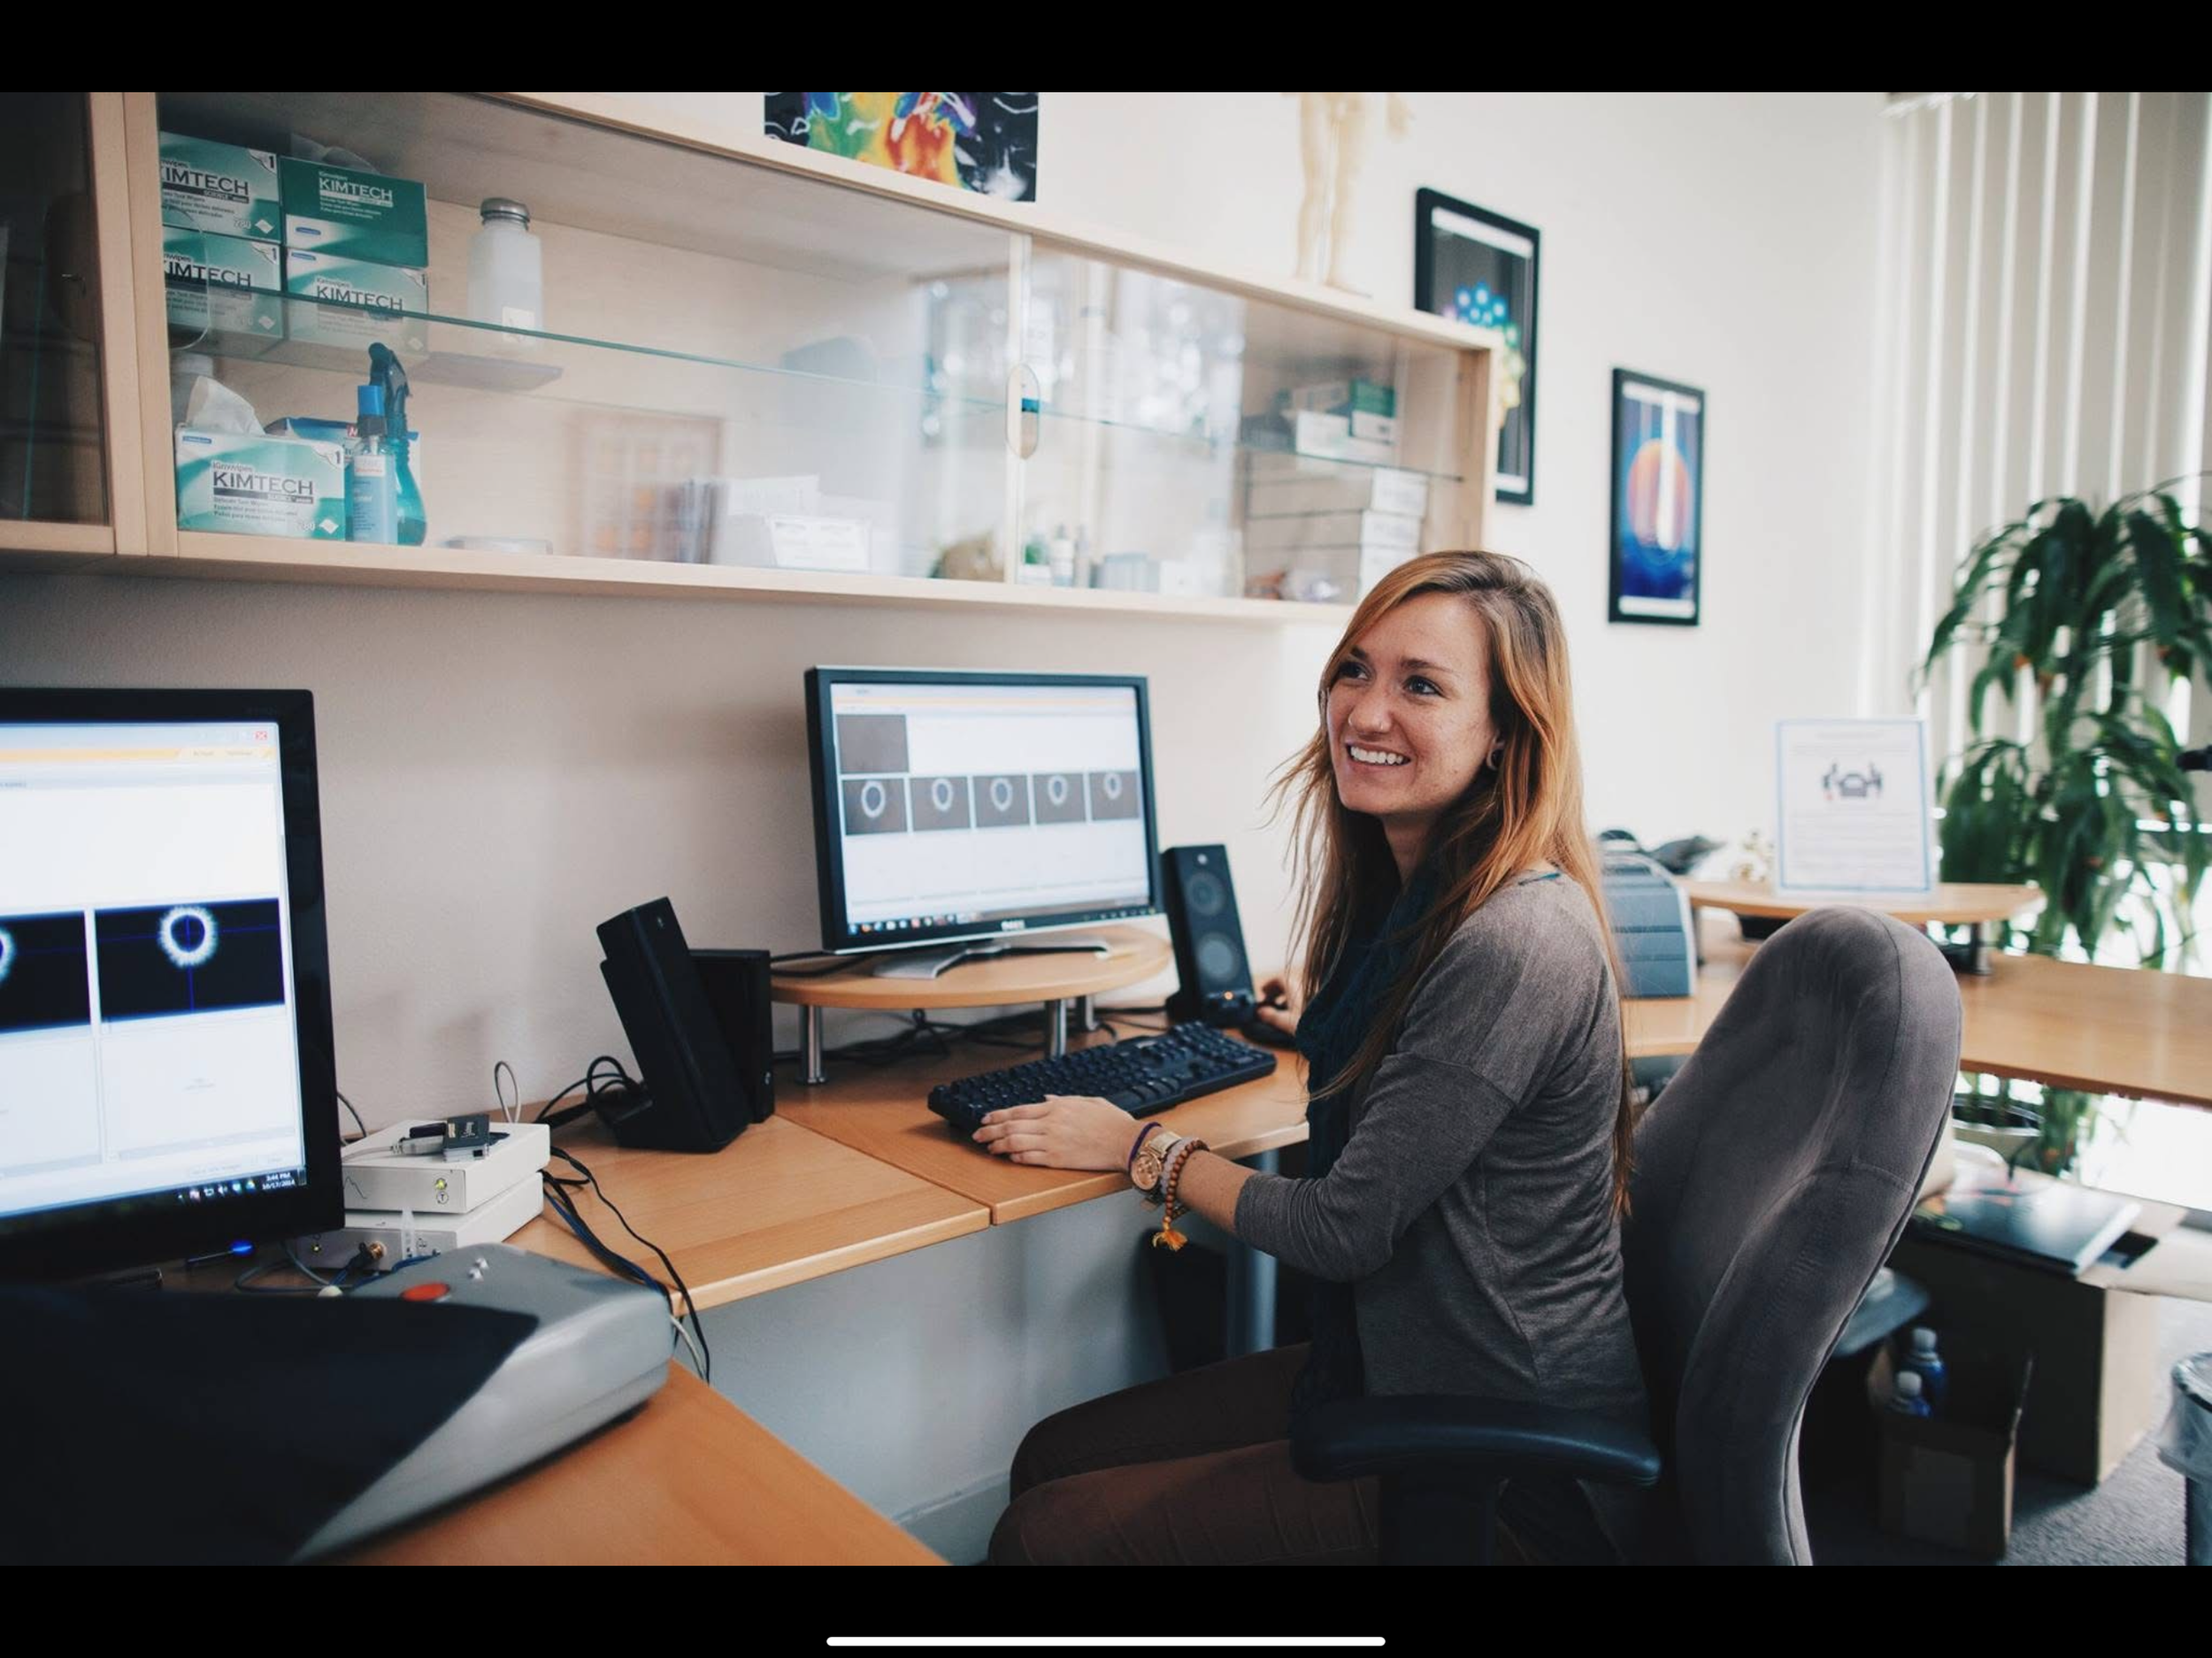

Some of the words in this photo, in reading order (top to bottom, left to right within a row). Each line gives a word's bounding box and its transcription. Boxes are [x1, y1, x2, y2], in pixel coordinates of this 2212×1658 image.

[268, 155, 274, 169] 1
[160, 166, 249, 196] IMTECH
[319, 177, 393, 202] KIMTECH
[164, 259, 251, 287] IMTECH
[317, 285, 403, 311] KIMTECH
[335, 451, 341, 464] 1
[213, 472, 314, 495] KIMTECH
